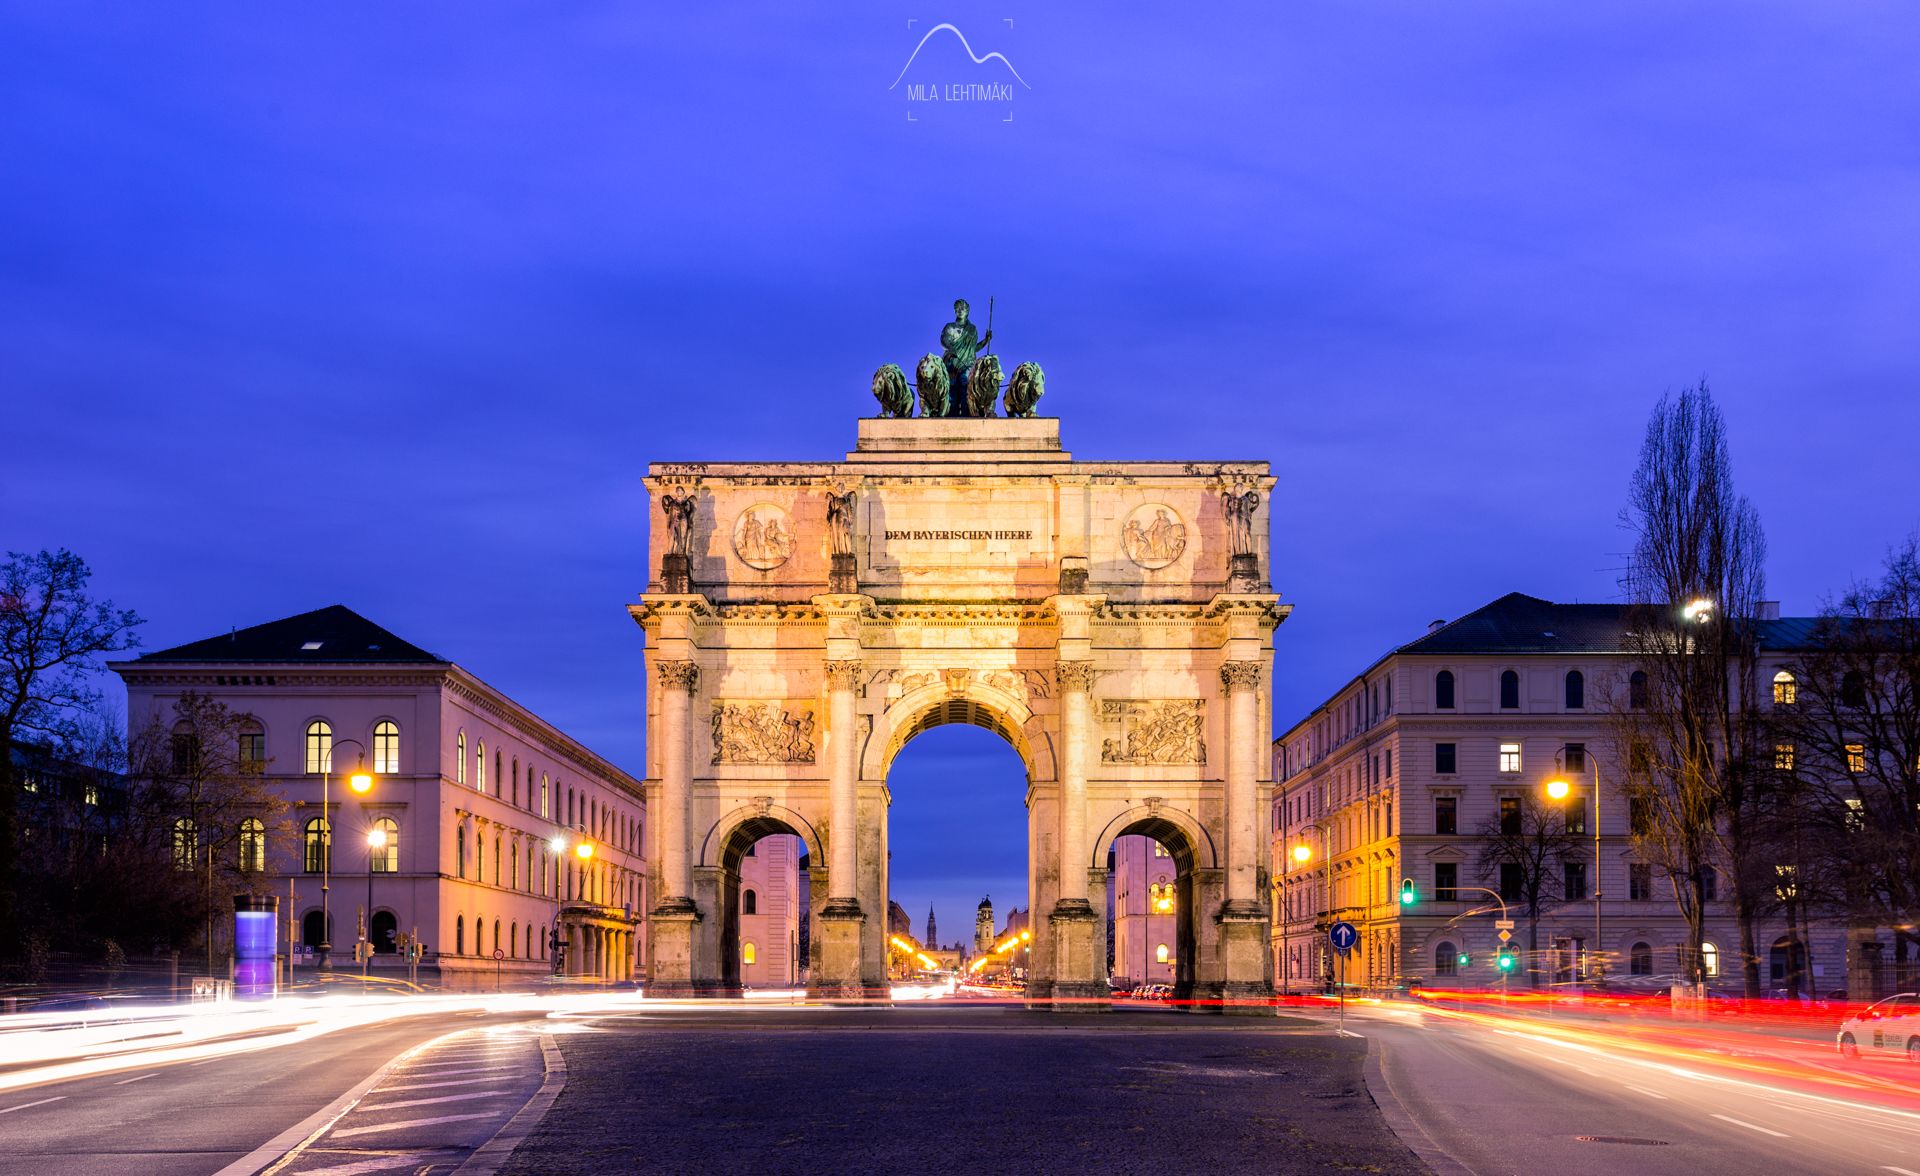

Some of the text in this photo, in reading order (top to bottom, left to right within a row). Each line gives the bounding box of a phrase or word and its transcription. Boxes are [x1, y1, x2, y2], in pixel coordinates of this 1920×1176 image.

[885, 530, 1033, 540] DEM BAYERISCHEN HEERE
